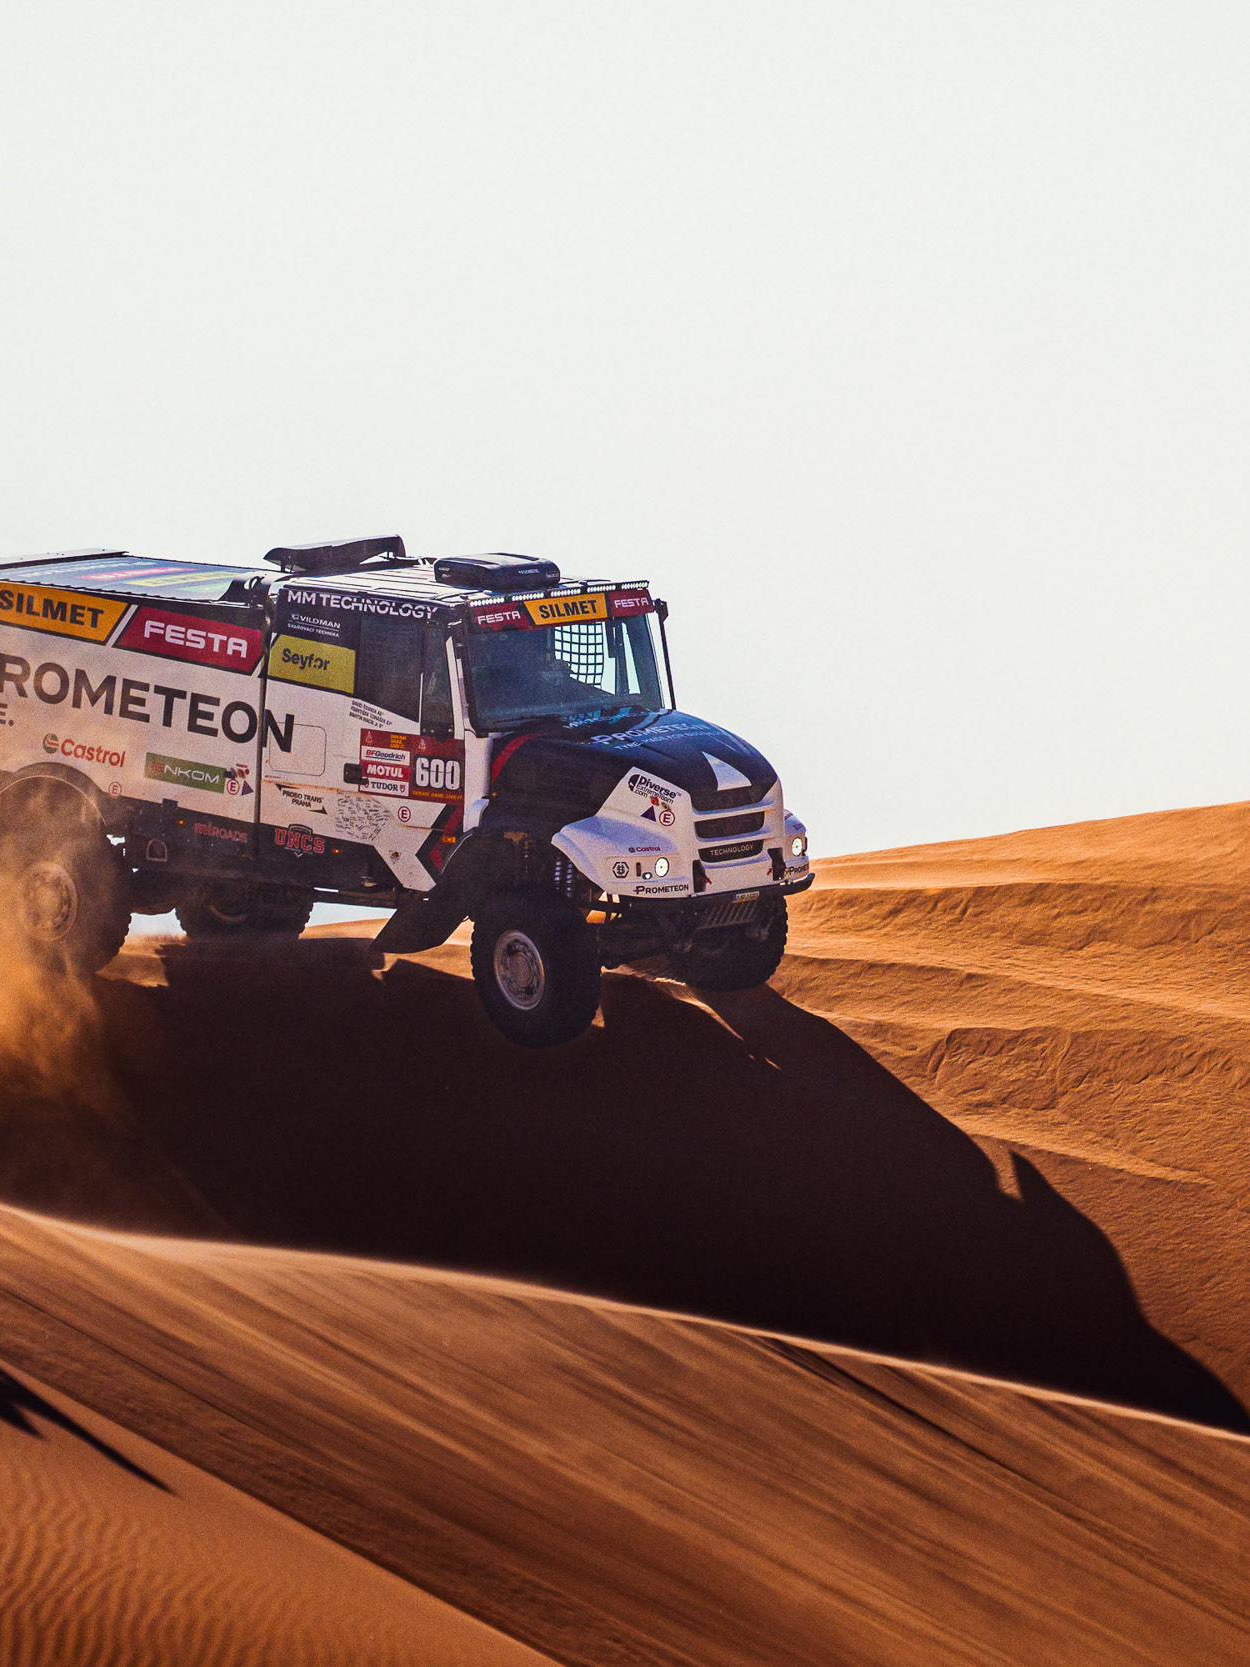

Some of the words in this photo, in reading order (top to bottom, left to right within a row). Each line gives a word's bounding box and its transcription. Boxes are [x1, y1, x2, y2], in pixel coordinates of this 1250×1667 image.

[288, 590, 316, 606] MM
[319, 592, 439, 620] TECHNOLOGY
[538, 599, 597, 620] SILMET
[614, 597, 649, 609] FESTA
[300, 615, 341, 629] VILDMAN
[477, 610, 521, 625] FESTA
[143, 620, 248, 658] FESTA
[61, 738, 126, 768] Castrol
[366, 749, 406, 760] BFGoodrich
[367, 764, 404, 778] MOTUL
[415, 757, 461, 791] 600
[370, 781, 399, 793] TUDOR
[638, 775, 677, 799] Diverse
[282, 790, 302, 799] PROBO
[304, 793, 323, 804] TRANS
[292, 798, 312, 808] PRAHA
[274, 828, 326, 854] UNCS
[709, 843, 754, 856] TECHNOLOGY
[633, 884, 689, 895] PROMETEON
